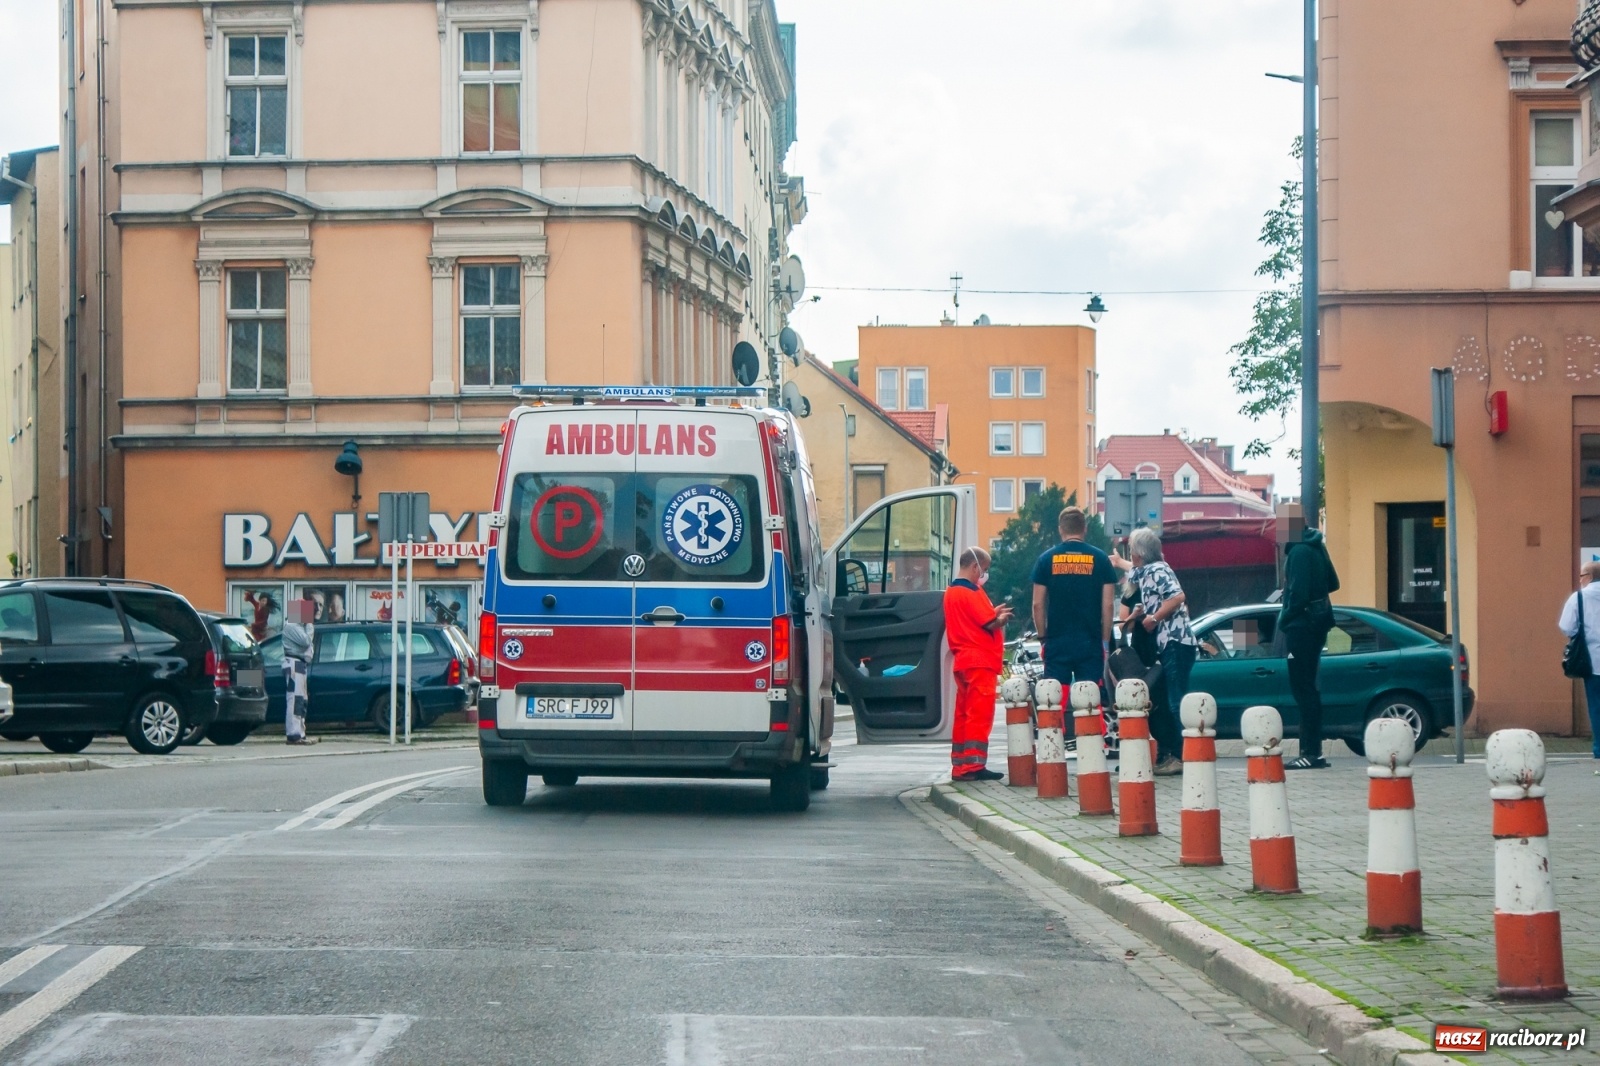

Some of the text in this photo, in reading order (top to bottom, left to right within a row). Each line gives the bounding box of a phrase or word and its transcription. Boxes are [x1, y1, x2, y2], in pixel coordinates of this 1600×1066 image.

[604, 388, 672, 396] AMBULANS
[545, 424, 716, 457] AMBULANS
[555, 501, 582, 543] P
[664, 487, 742, 542] PAŃSTWOWE RATOWNICTWO
[223, 513, 489, 567] BAŁY
[677, 549, 729, 564] MEDYCZNE
[537, 699, 566, 714] SRC
